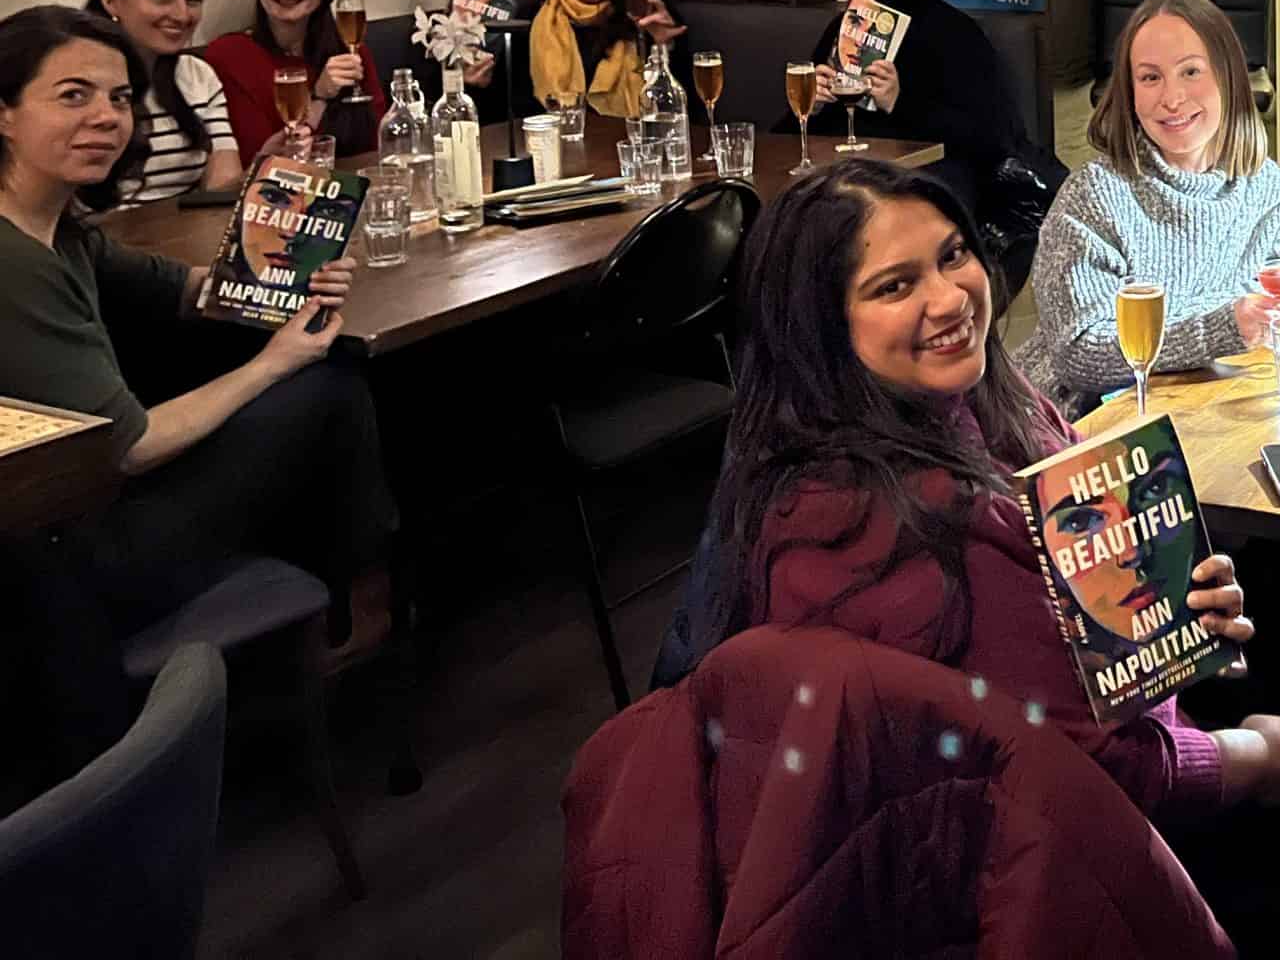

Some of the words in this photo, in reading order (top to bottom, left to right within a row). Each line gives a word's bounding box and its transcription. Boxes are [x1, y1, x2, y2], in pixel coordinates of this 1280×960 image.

[243, 203, 346, 241] BEAUTIFUL
[218, 281, 311, 312] NAPOLITAN
[259, 266, 297, 287] ANN
[1066, 446, 1151, 504] HELLO
[1018, 494, 1041, 548] HELLO
[1055, 493, 1195, 580] BEAUTIFUL
[1130, 597, 1174, 641] ANN
[1096, 620, 1211, 697] NAPOLITAN
[1145, 684, 1163, 700] DEAR
[1165, 664, 1197, 688] EDWARD
